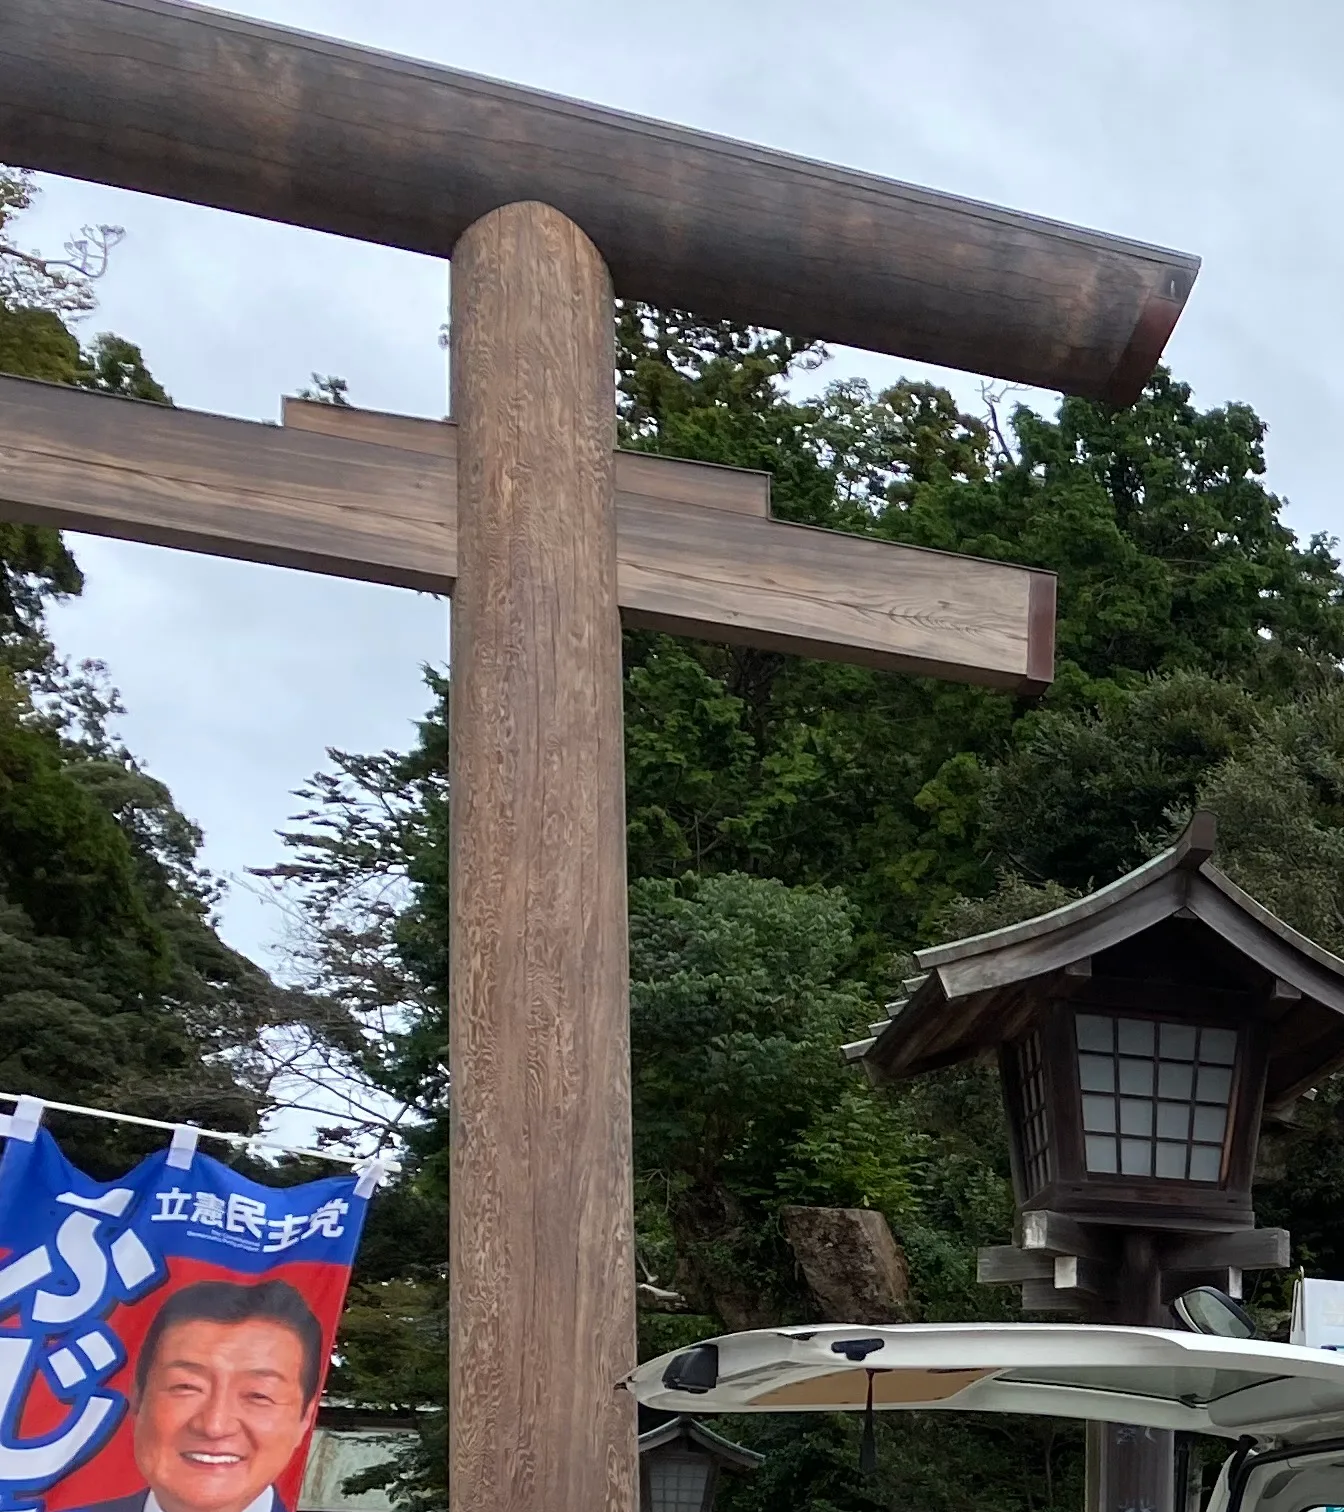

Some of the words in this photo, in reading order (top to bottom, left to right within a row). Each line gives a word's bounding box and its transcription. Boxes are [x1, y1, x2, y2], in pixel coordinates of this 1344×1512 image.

[151, 1187, 349, 1253] 立憲民主党
